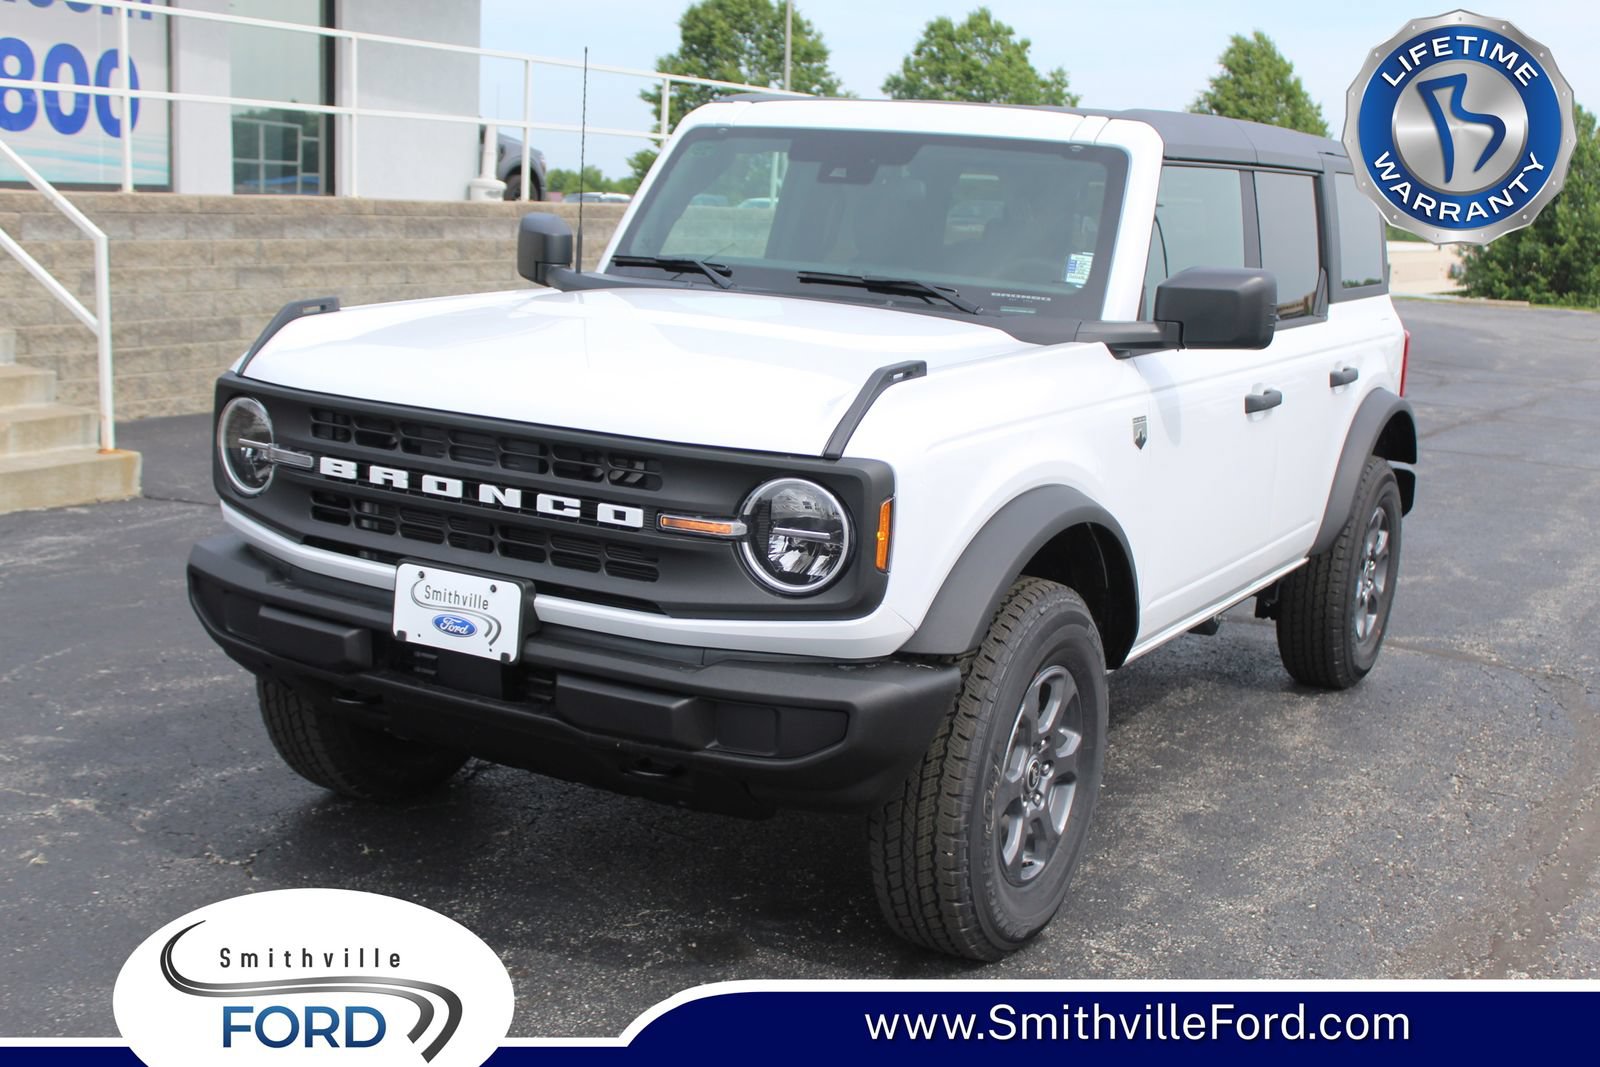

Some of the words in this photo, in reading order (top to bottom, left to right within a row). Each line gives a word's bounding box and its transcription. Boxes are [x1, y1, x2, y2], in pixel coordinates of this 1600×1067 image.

[319, 456, 644, 529] BRONCO
[424, 585, 489, 611] Smithville
[439, 617, 470, 636] Ford
